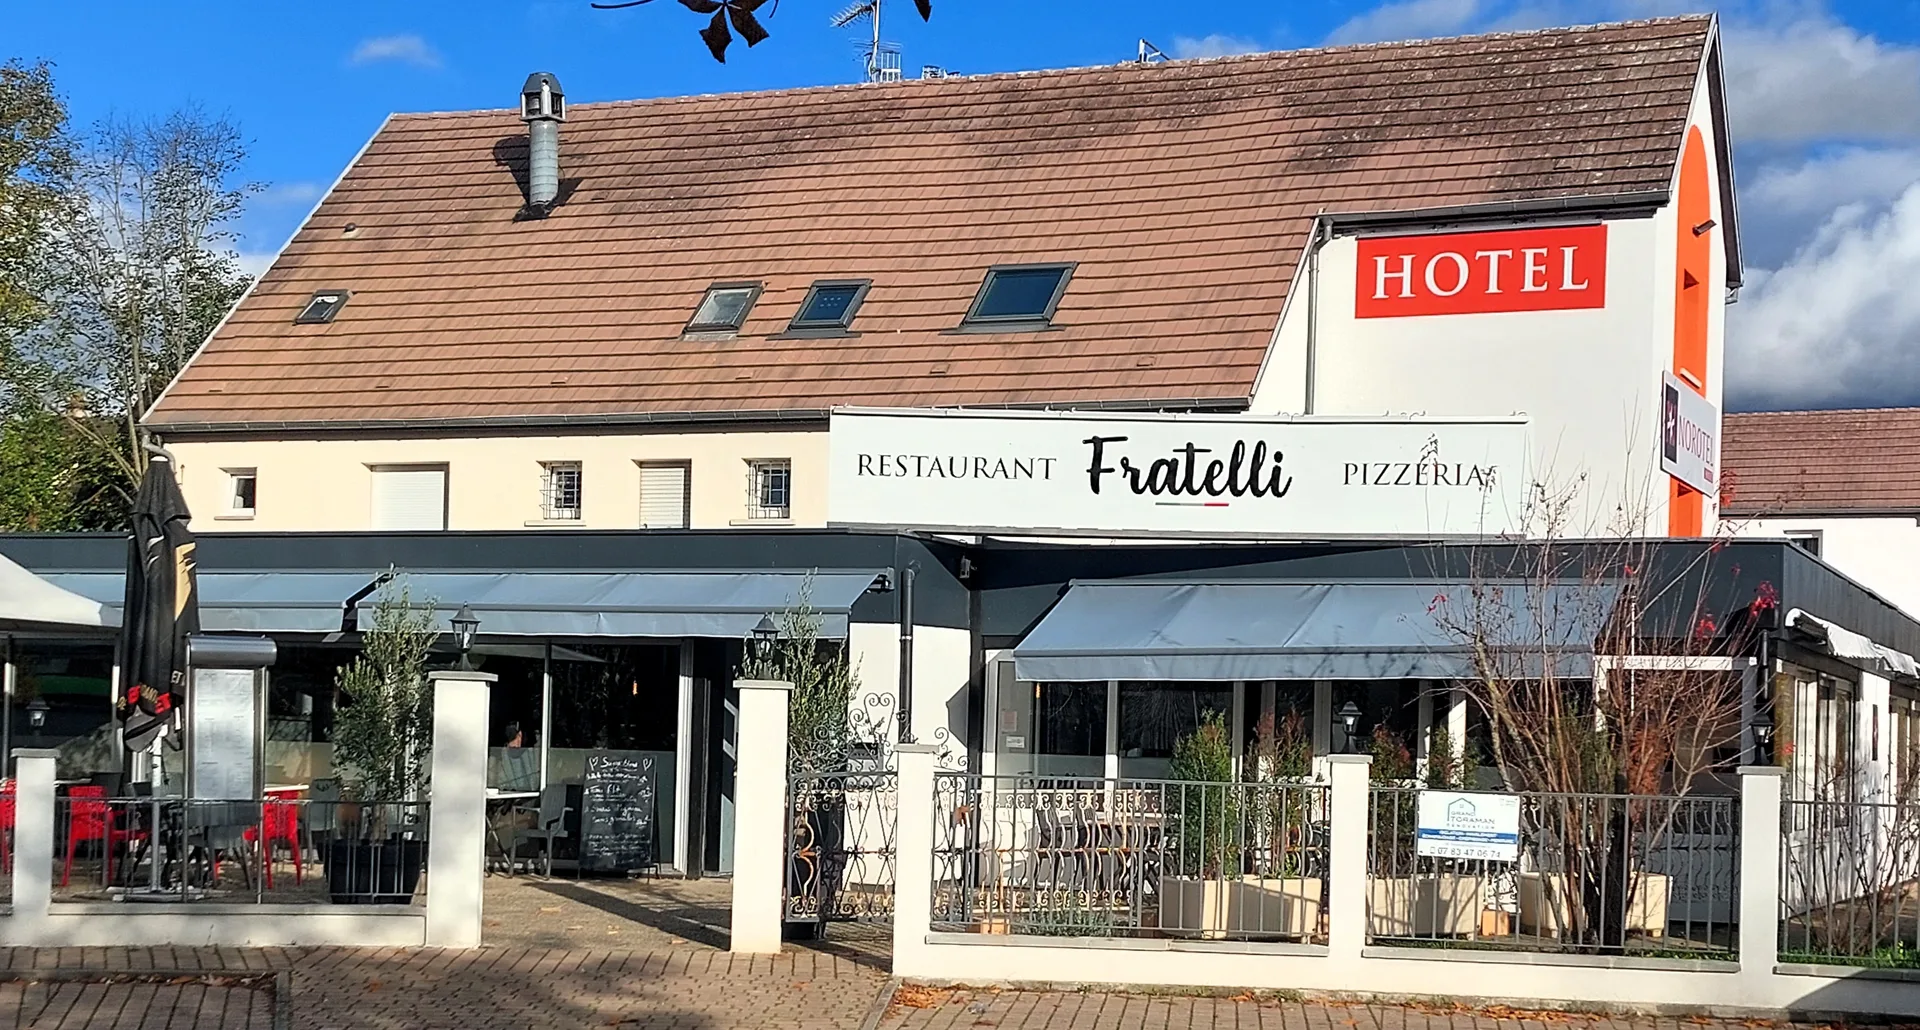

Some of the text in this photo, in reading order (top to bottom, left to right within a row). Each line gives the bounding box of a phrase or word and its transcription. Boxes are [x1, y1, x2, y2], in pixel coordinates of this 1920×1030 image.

[1372, 246, 1589, 299] HOTEL
[857, 435, 1485, 498] RESTAURANT Fratelli PIZZERIA
[1678, 415, 1714, 467] NOROTEL
[1451, 816, 1495, 824] TORAMAN
[1437, 846, 1448, 854] 07
[1463, 849, 1474, 857] 47
